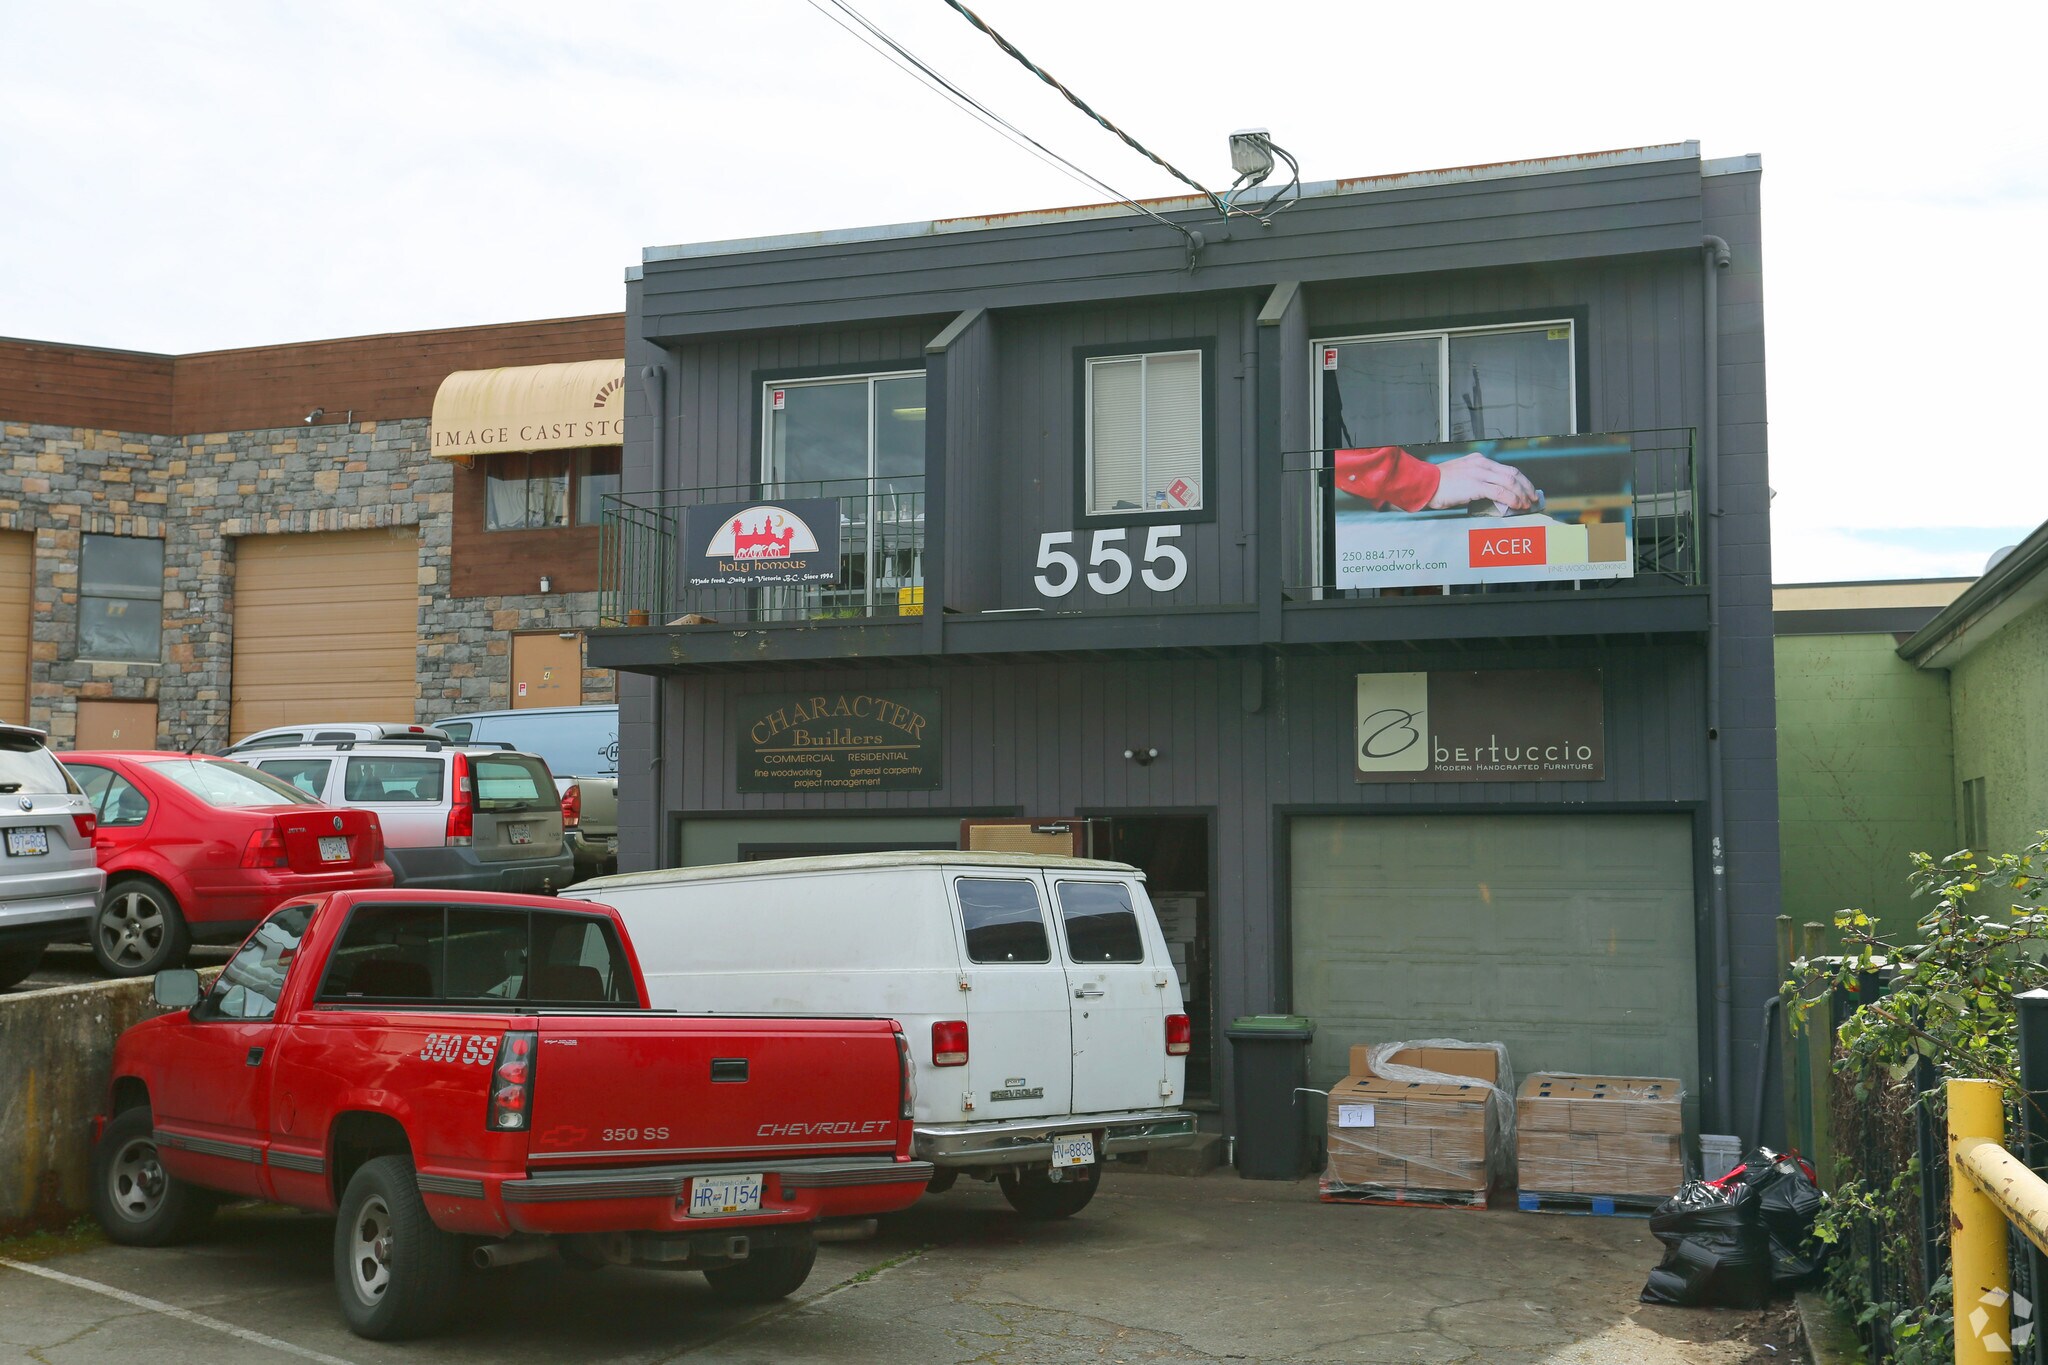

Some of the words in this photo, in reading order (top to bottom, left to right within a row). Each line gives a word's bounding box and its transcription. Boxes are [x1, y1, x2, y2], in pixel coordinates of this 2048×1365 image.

[435, 427, 508, 447] IMAGE
[520, 422, 577, 442] CAST
[1481, 538, 1532, 556] ACER
[1033, 524, 1188, 598] 555
[1341, 549, 1415, 562] 250.884.7179
[754, 559, 806, 571] homous
[1341, 559, 1448, 574] acerwoodwork.com
[1566, 562, 1627, 572] WOODWORKING
[690, 577, 710, 586] Made
[727, 576, 747, 585] Daily
[755, 574, 782, 583] Victoria
[801, 572, 819, 581] Since
[820, 572, 834, 580] 1994
[751, 695, 926, 745] CHARACTER
[792, 728, 883, 747] Builders
[763, 753, 836, 764] COMMERCIAL
[847, 752, 909, 762] RESIDENTIAL
[754, 769, 769, 777] fine
[770, 768, 822, 778] woodworking
[849, 767, 881, 777] general
[882, 766, 923, 776] carpentry
[1434, 763, 1472, 772] MODERN
[1476, 763, 1540, 771] HANDCRAFTED
[1543, 762, 1594, 770] FURNITURE
[794, 778, 823, 788] project
[824, 778, 881, 787] management
[420, 1033, 462, 1063] 350
[462, 1034, 498, 1066] SS
[990, 1087, 1044, 1102] CHEVROLET
[602, 1128, 638, 1141] 350
[643, 1127, 670, 1140] SS
[756, 1120, 891, 1137] CHEVROLET
